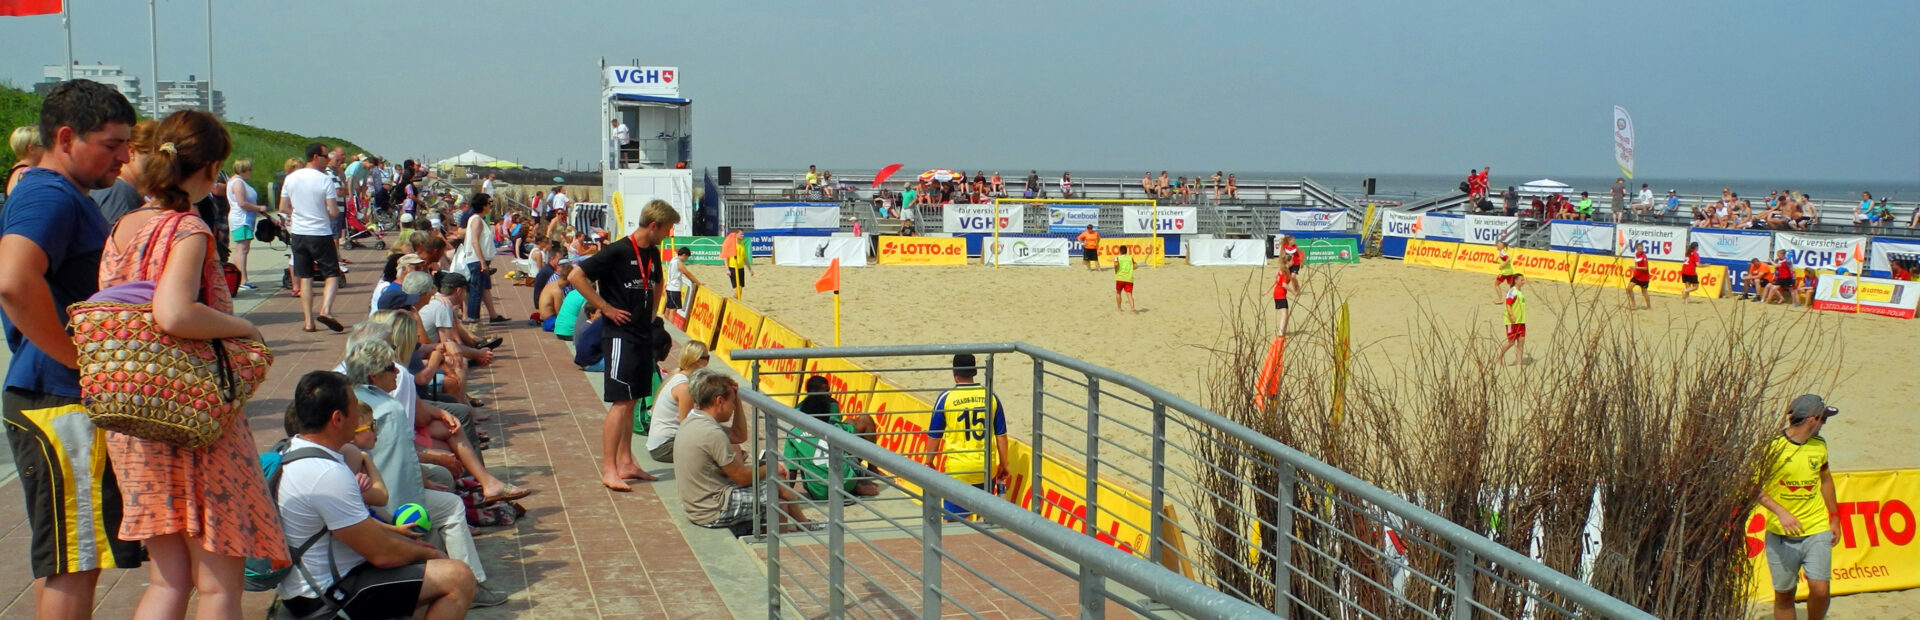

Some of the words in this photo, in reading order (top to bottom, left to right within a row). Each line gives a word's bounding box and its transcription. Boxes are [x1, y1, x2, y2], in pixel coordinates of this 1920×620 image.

[614, 69, 659, 84] VGH
[784, 207, 807, 217] ahoi!
[958, 207, 971, 215] fair
[972, 207, 1008, 215] versicert
[1067, 211, 1097, 220] facebook
[959, 217, 995, 230] VGH
[1138, 218, 1173, 231] VGH
[1296, 218, 1331, 226] Tourismus
[1389, 221, 1410, 234] VGH
[1484, 219, 1508, 227] versichert
[1474, 227, 1499, 241] VGH
[1629, 228, 1639, 236] fair
[1641, 229, 1673, 239] versichert
[1629, 238, 1661, 255] VGH
[1717, 235, 1738, 247] ahoi!
[1790, 236, 1804, 247] fair
[1806, 238, 1848, 249] versichert
[900, 243, 962, 255] LOTTO.de
[1416, 246, 1453, 259] LOTTO.de
[1525, 255, 1570, 272] LOTTO.de
[1791, 249, 1832, 267] VGH
[953, 396, 987, 406] CHAOS-BUTT
[957, 406, 986, 441] 15
[1834, 499, 1917, 549] TTO
